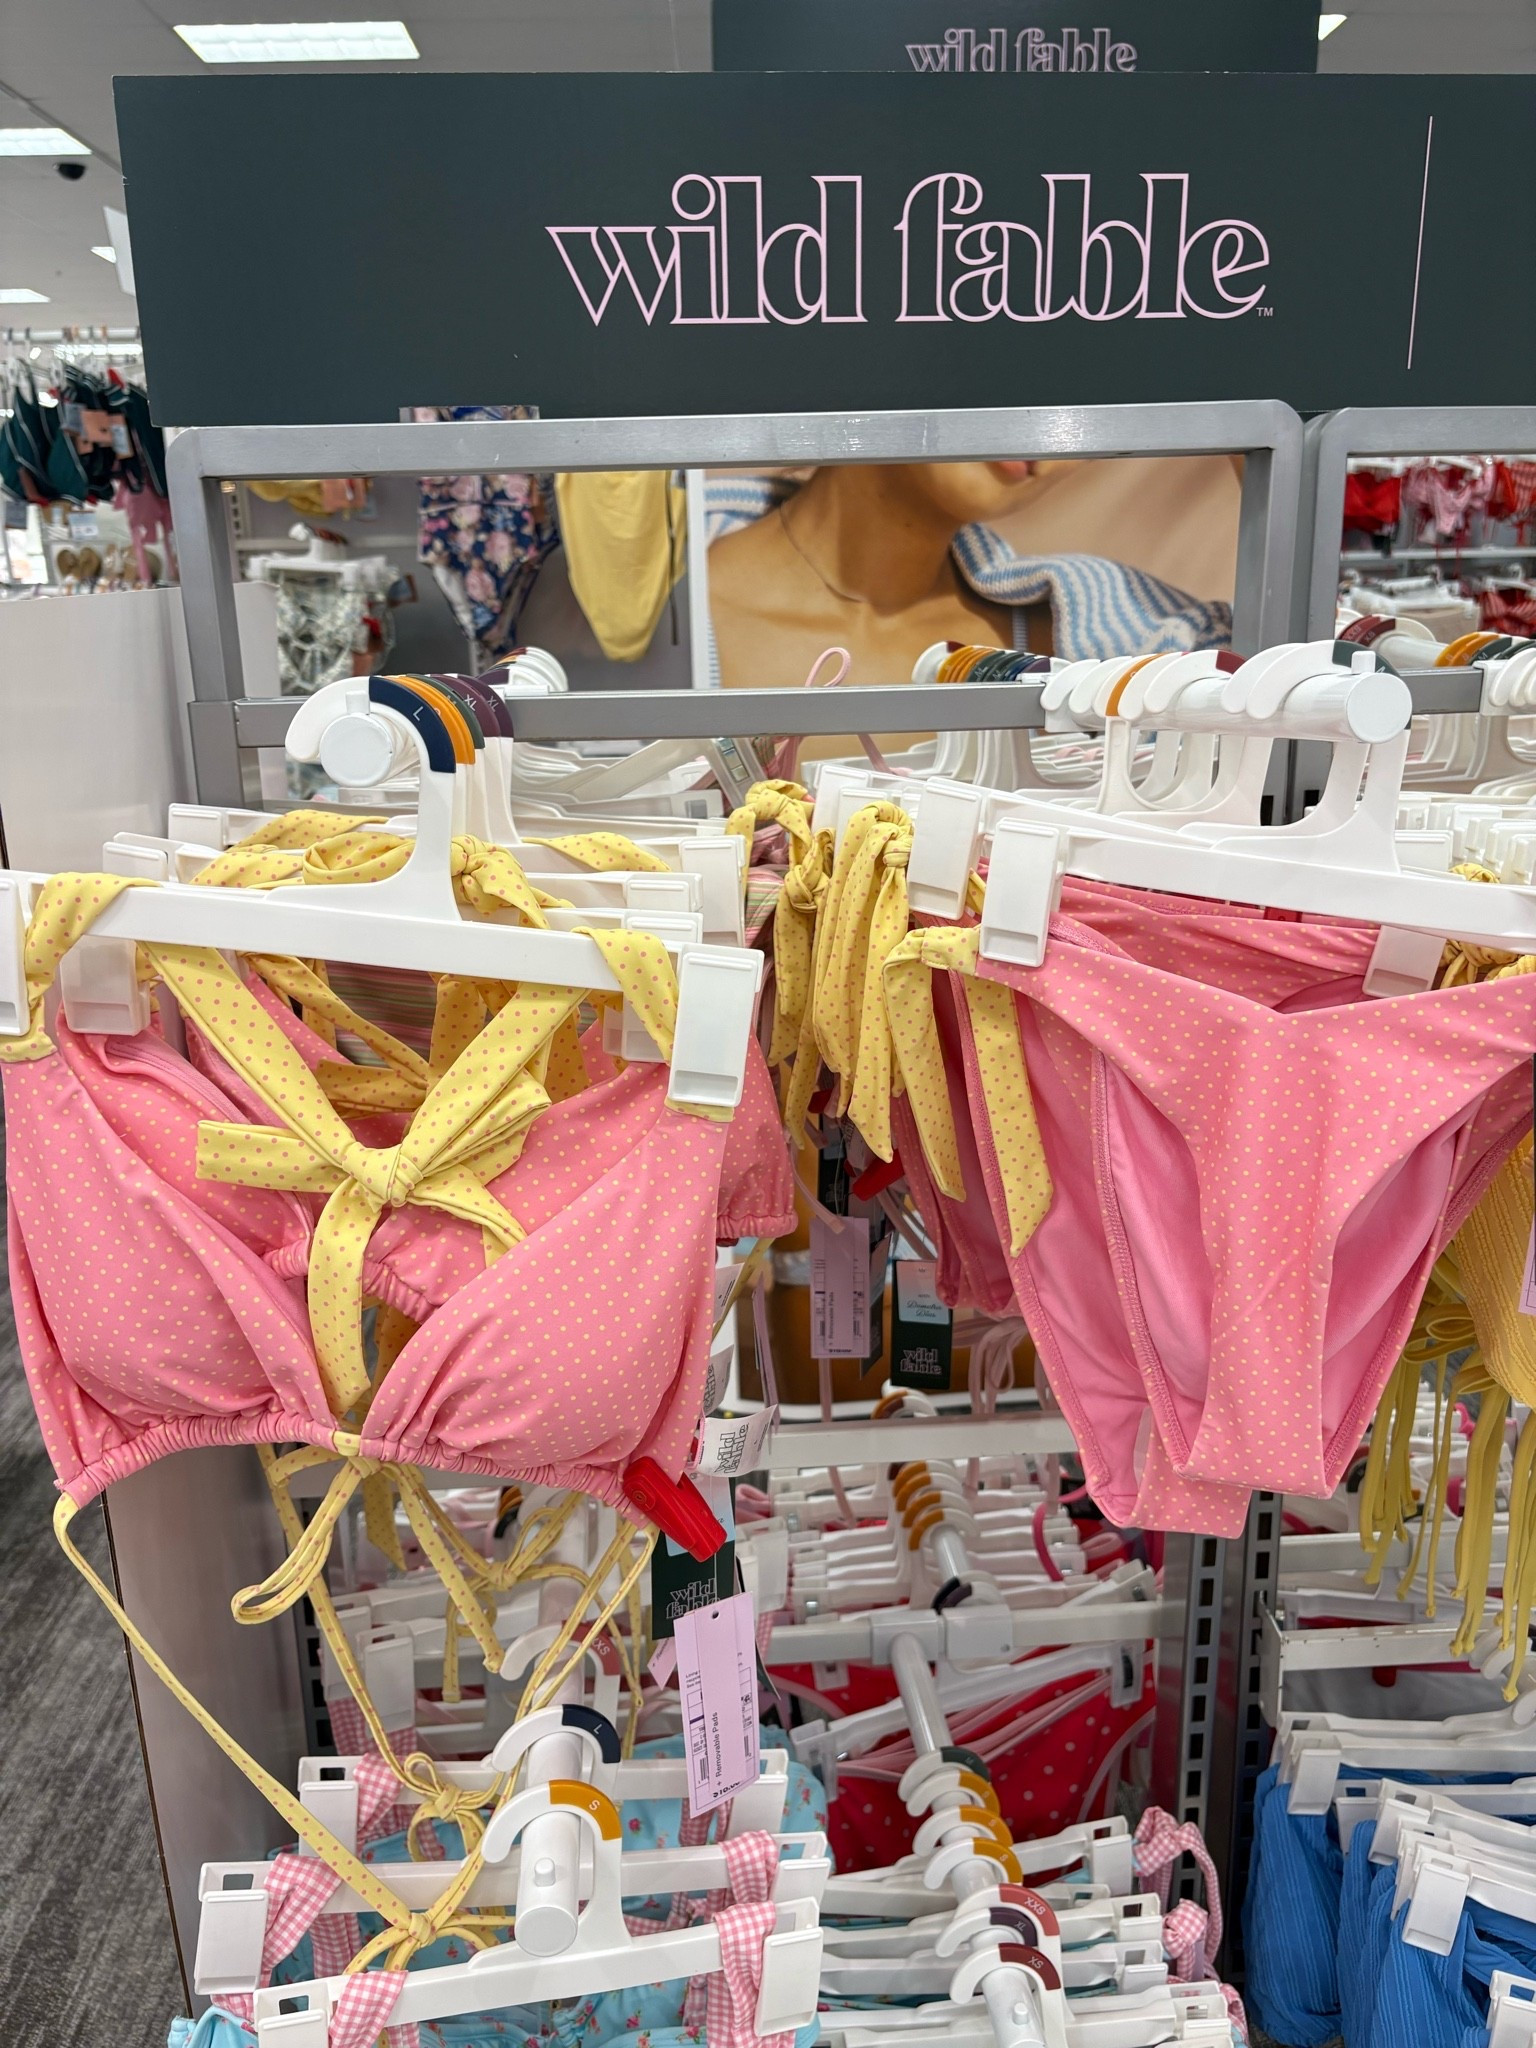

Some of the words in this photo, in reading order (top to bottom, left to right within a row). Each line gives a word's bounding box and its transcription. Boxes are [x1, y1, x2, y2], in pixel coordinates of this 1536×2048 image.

[905, 28, 1007, 72] wild
[1014, 28, 1138, 72] fable
[545, 173, 868, 326] wild
[893, 172, 1269, 322] fable
[464, 694, 478, 712] XL
[487, 696, 499, 712] XL
[412, 706, 424, 721] L
[903, 1347, 938, 1363] wild
[900, 1358, 942, 1375] fable
[714, 1432, 736, 1473] wild
[724, 1423, 749, 1474] fable
[669, 1578, 716, 1601] wild
[593, 1723, 602, 1735] L
[711, 1712, 719, 1733] Pads
[714, 1733, 723, 1778] Removable
[588, 1799, 600, 1811] S
[1024, 1897, 1046, 1915] XXS
[1014, 1921, 1027, 1932] XL
[1028, 1956, 1044, 1969] XS
